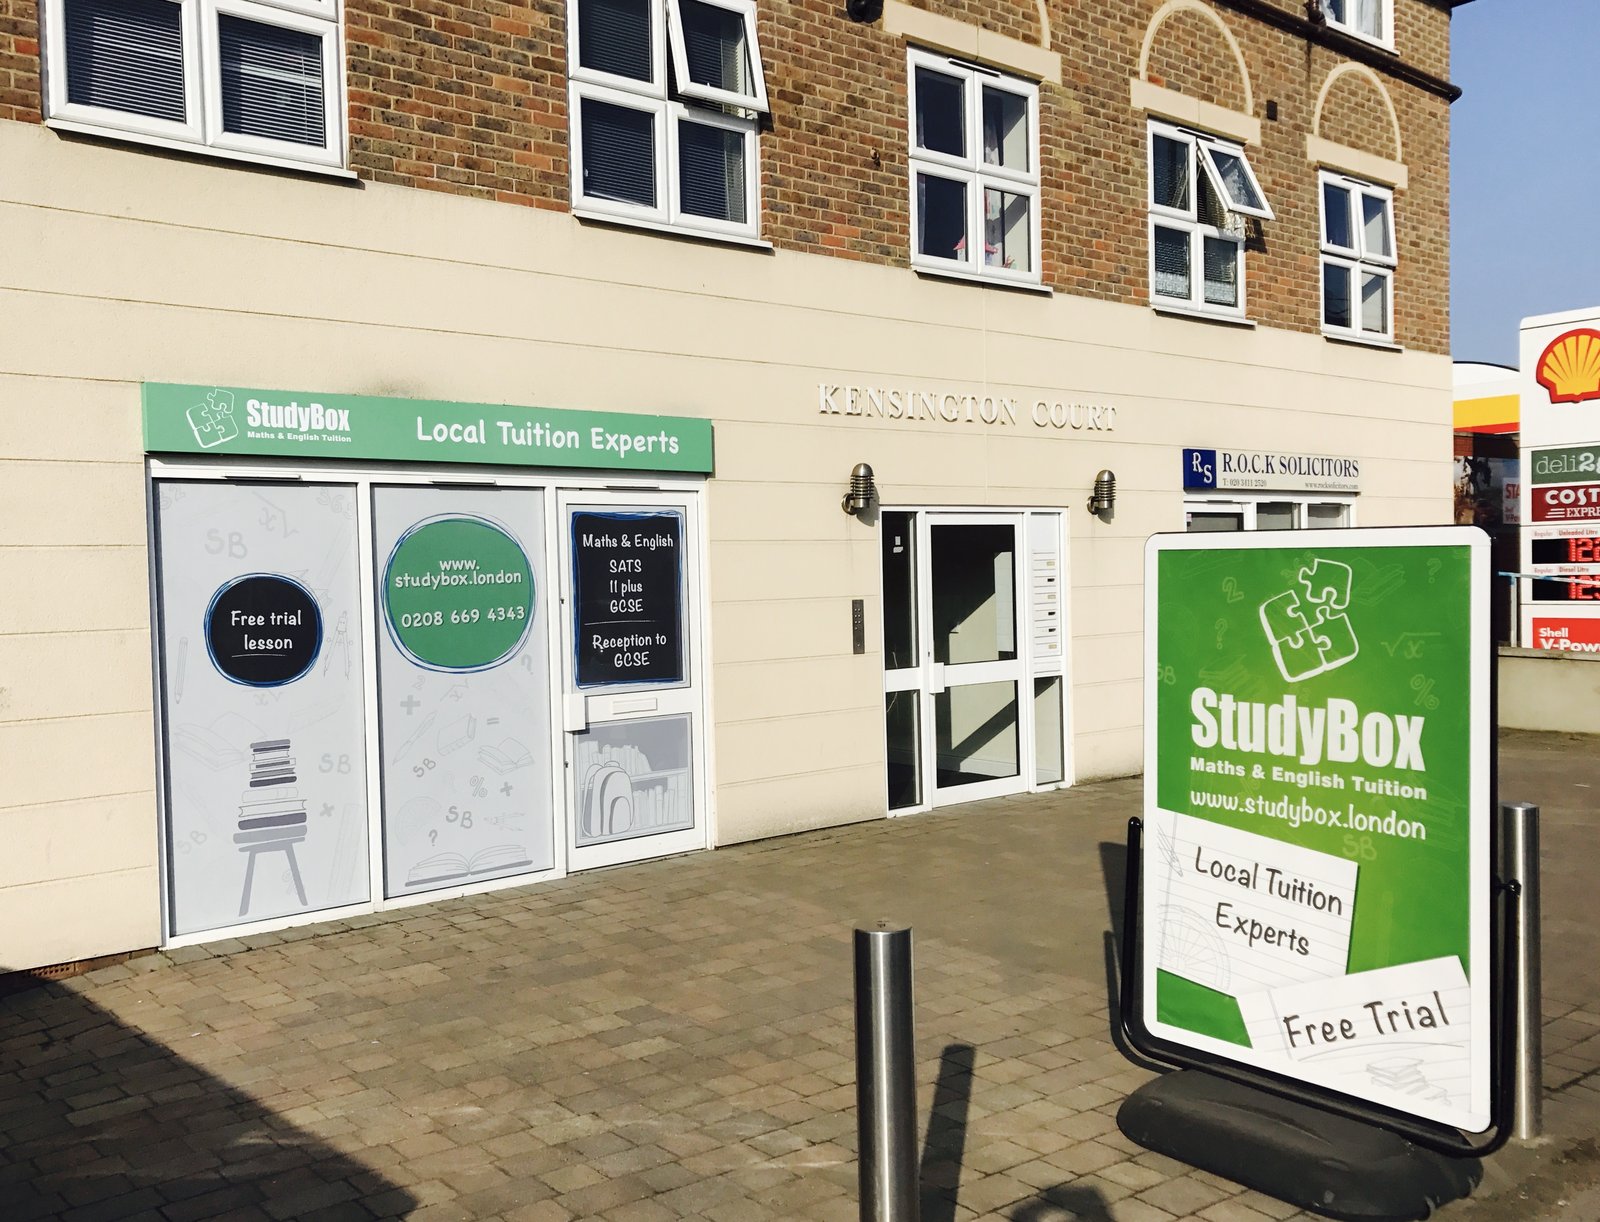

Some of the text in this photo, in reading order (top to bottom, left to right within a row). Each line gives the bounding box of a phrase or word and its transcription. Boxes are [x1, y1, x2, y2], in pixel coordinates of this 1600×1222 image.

[246, 399, 350, 432] StudyBox
[817, 383, 1117, 431] KENSINGTON COURT
[247, 431, 275, 440] Maths
[287, 433, 321, 442] English
[322, 434, 351, 443] Tuition
[416, 416, 680, 458] Local Tuition Experts
[1222, 452, 1359, 478] R.O.C.K SOLICITORS
[204, 527, 248, 560] SB
[582, 533, 674, 551] Maths & English
[439, 559, 480, 572] www.
[609, 559, 643, 573] SATS
[395, 569, 523, 590] studybox.london
[621, 579, 643, 596] plus
[401, 606, 526, 629] 0208 669 4343
[609, 599, 644, 613] GCSE
[230, 609, 302, 627] Free trial
[244, 634, 293, 650] lesson
[592, 633, 667, 652] Reception to
[1539, 627, 1569, 638] Shell
[1540, 638, 1600, 653] V-Pow
[613, 651, 650, 668] GCSE
[1190, 687, 1426, 772] StudyBox
[317, 752, 352, 775] SB
[412, 757, 437, 779] SB
[1190, 756, 1428, 801] Maths & English Tuition
[445, 805, 474, 830] SB
[1190, 790, 1427, 841] www.studybox.london
[1342, 834, 1378, 861] SB
[1194, 846, 1343, 916] Local Tuition
[1215, 901, 1310, 957] Experts
[1282, 990, 1451, 1050] Free Trial
